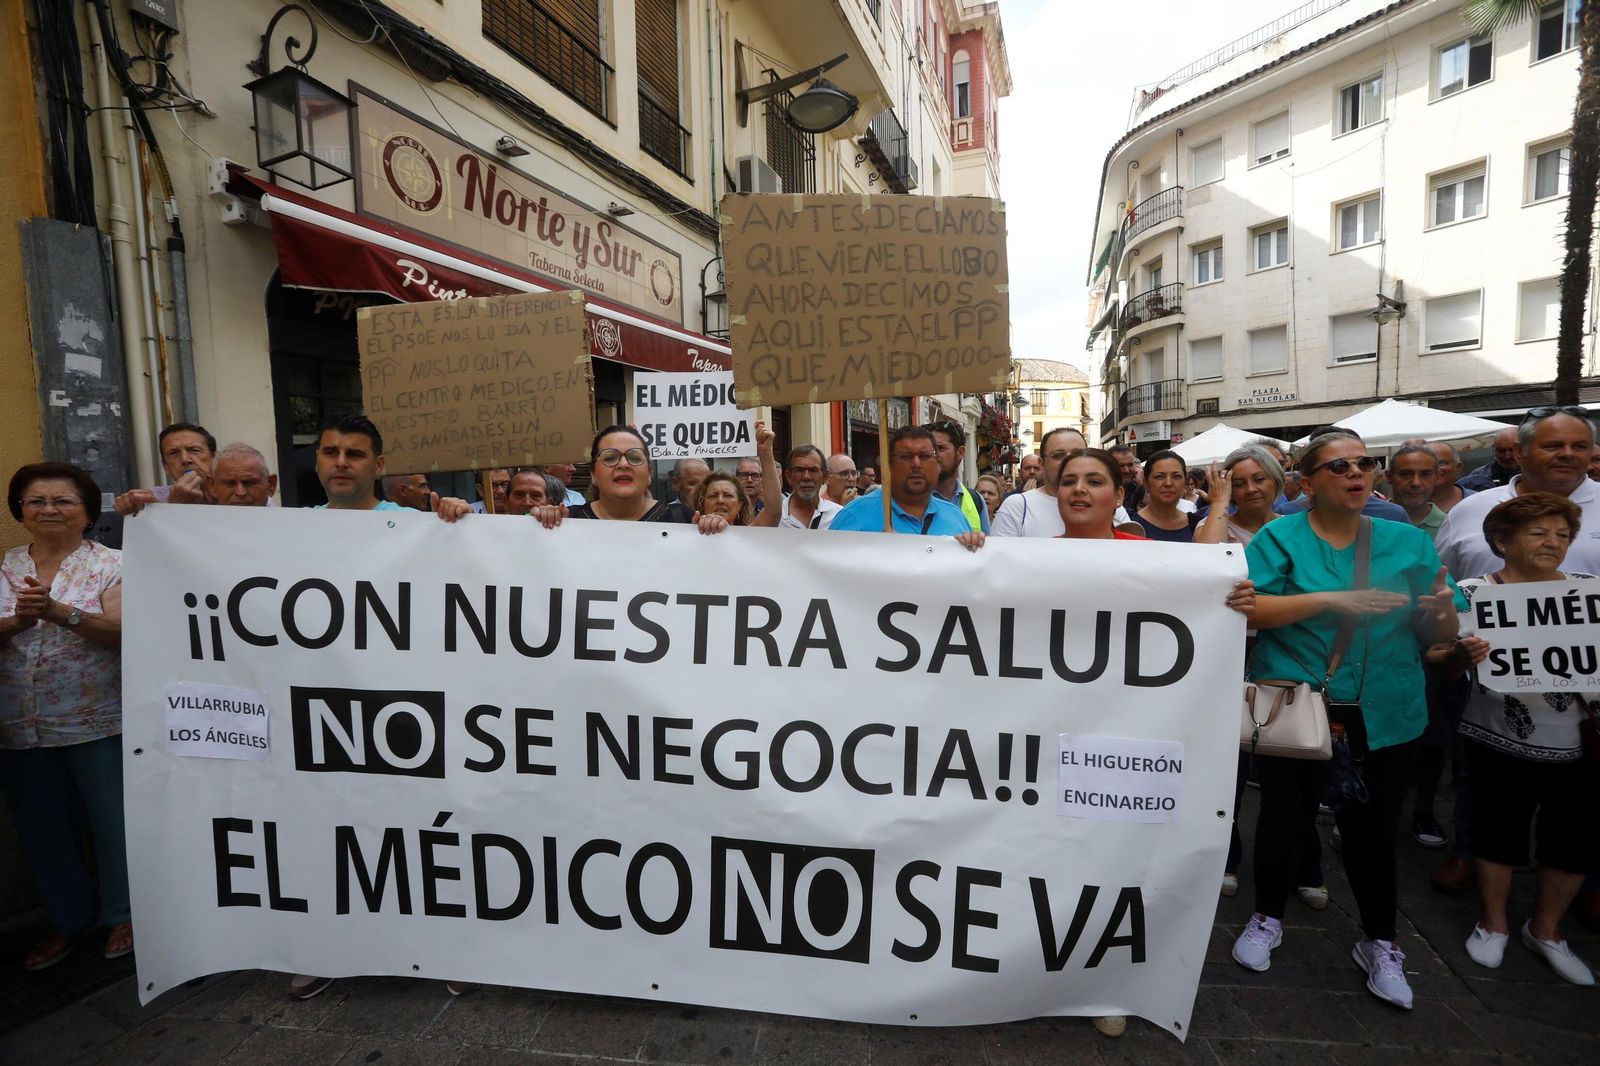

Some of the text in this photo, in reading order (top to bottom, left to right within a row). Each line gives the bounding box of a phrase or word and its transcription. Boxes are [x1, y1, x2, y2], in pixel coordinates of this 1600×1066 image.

[456, 154, 642, 278] Norte y Sur
[397, 259, 472, 300] Pint
[529, 251, 604, 293] Taberna Selecta
[842, 278, 974, 309] DECIMOS
[372, 309, 427, 335] ESTA
[457, 303, 478, 320] LA
[488, 298, 575, 319] DIFERENCIA
[921, 313, 947, 342] EL
[952, 303, 1000, 341] PP
[367, 337, 387, 355] EL
[392, 330, 435, 351] PSOE
[477, 325, 496, 341] LO
[504, 322, 530, 336] DA
[537, 320, 549, 336] Y
[555, 316, 577, 334] EL
[366, 359, 398, 390] PP
[447, 355, 469, 374] LO
[473, 350, 536, 373] QUITA
[370, 395, 392, 412] EL
[396, 385, 460, 408] CENTRO
[553, 368, 580, 390] EN
[636, 379, 737, 408] EL MÉDIC
[1252, 387, 1280, 395] PLAZA
[1256, 393, 1296, 403] NICOLAS
[478, 395, 557, 423] BARRIO
[409, 426, 482, 450] SANIDAD
[512, 417, 539, 435] UN
[461, 431, 564, 458] DERECHO
[641, 420, 750, 448] SE QUEDA
[1475, 589, 1600, 629] EL MÉD
[183, 576, 1195, 688] ¡¡CON NUESTRA SALUD
[1489, 645, 1598, 680] SE QU
[168, 696, 266, 717] VILLARRUBIA
[169, 727, 267, 749] LOS ÁNGELES
[306, 698, 1041, 807] NO SE NEGOCIA!!
[1061, 751, 1182, 773] EL HIGUERÓN
[1064, 789, 1176, 811] ENCINAREJO
[212, 811, 1147, 974] EL MÉDICO NO SE VA
